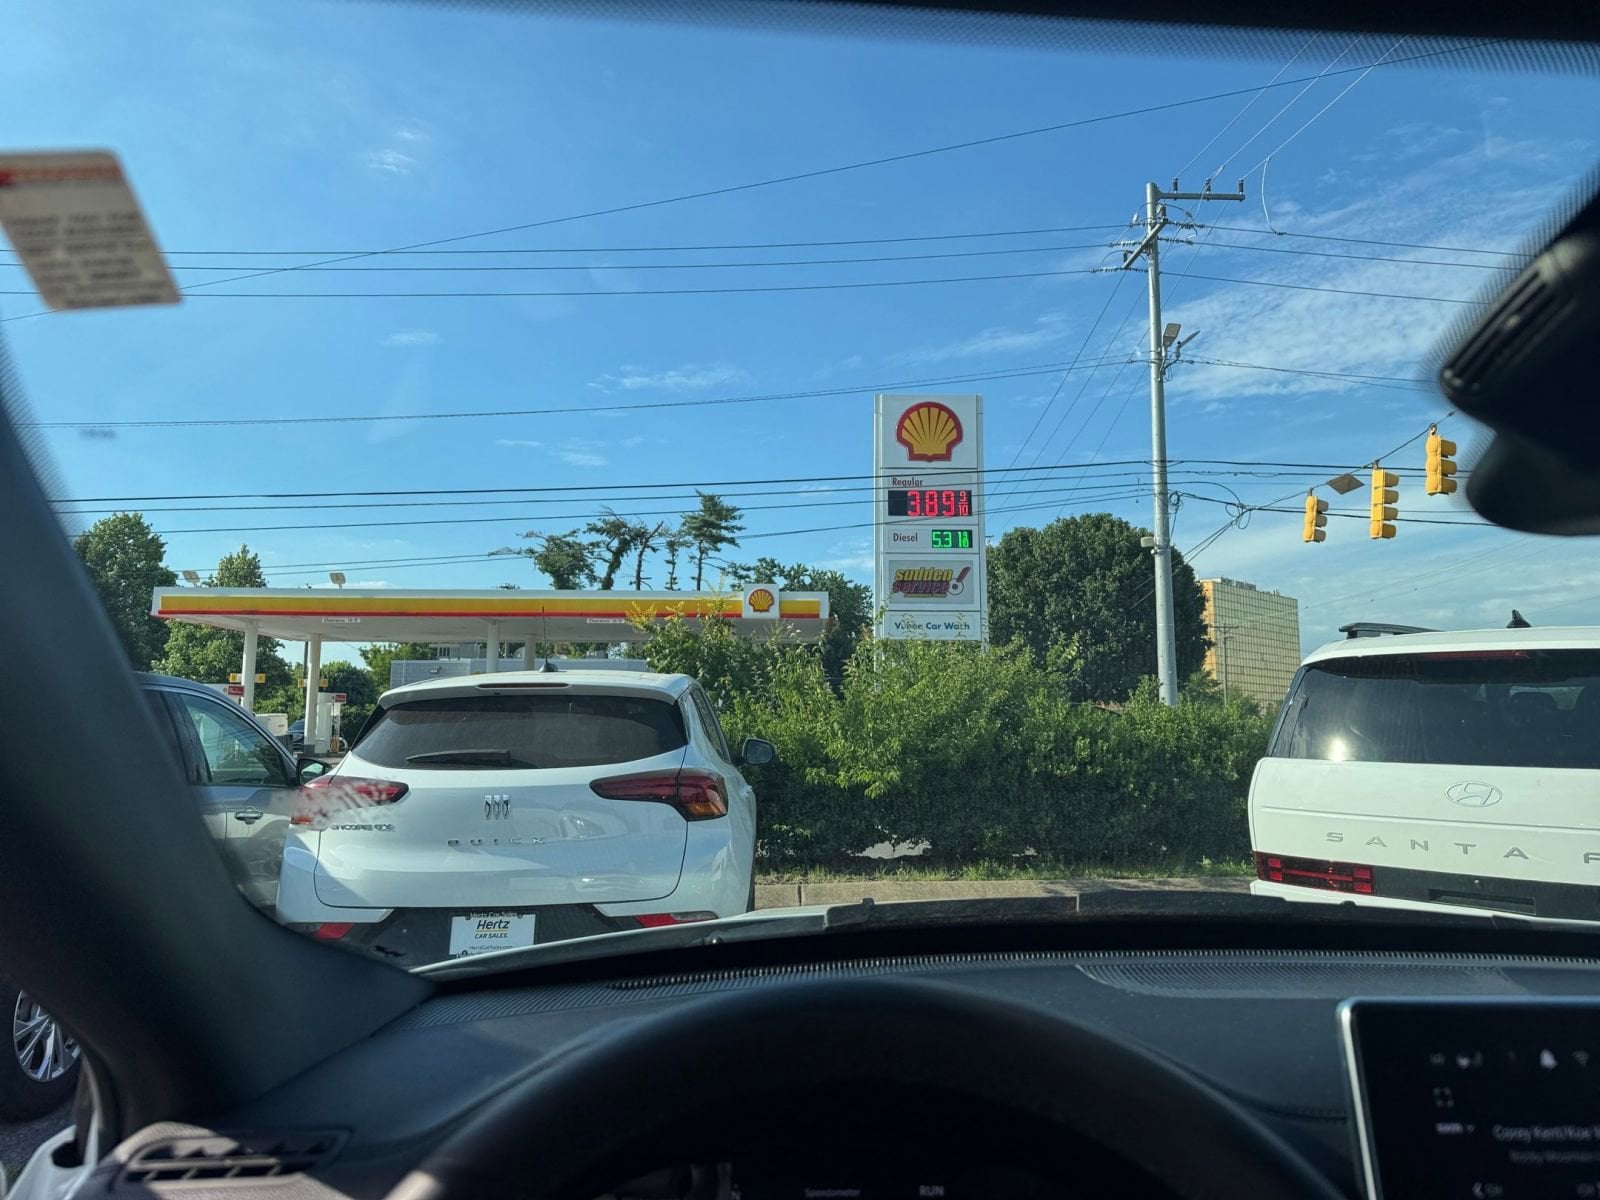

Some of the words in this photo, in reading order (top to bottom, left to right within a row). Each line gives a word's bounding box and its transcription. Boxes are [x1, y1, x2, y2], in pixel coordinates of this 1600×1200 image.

[892, 477, 923, 487] Regular
[907, 490, 955, 516] 3.89
[893, 532, 918, 542] Diesel
[895, 567, 953, 581] sudden
[925, 622, 942, 630] Car
[447, 838, 545, 846] BUICK
[1326, 832, 1529, 859] SANTA
[476, 920, 510, 930] Hertz
[919, 1185, 944, 1196] RUN
